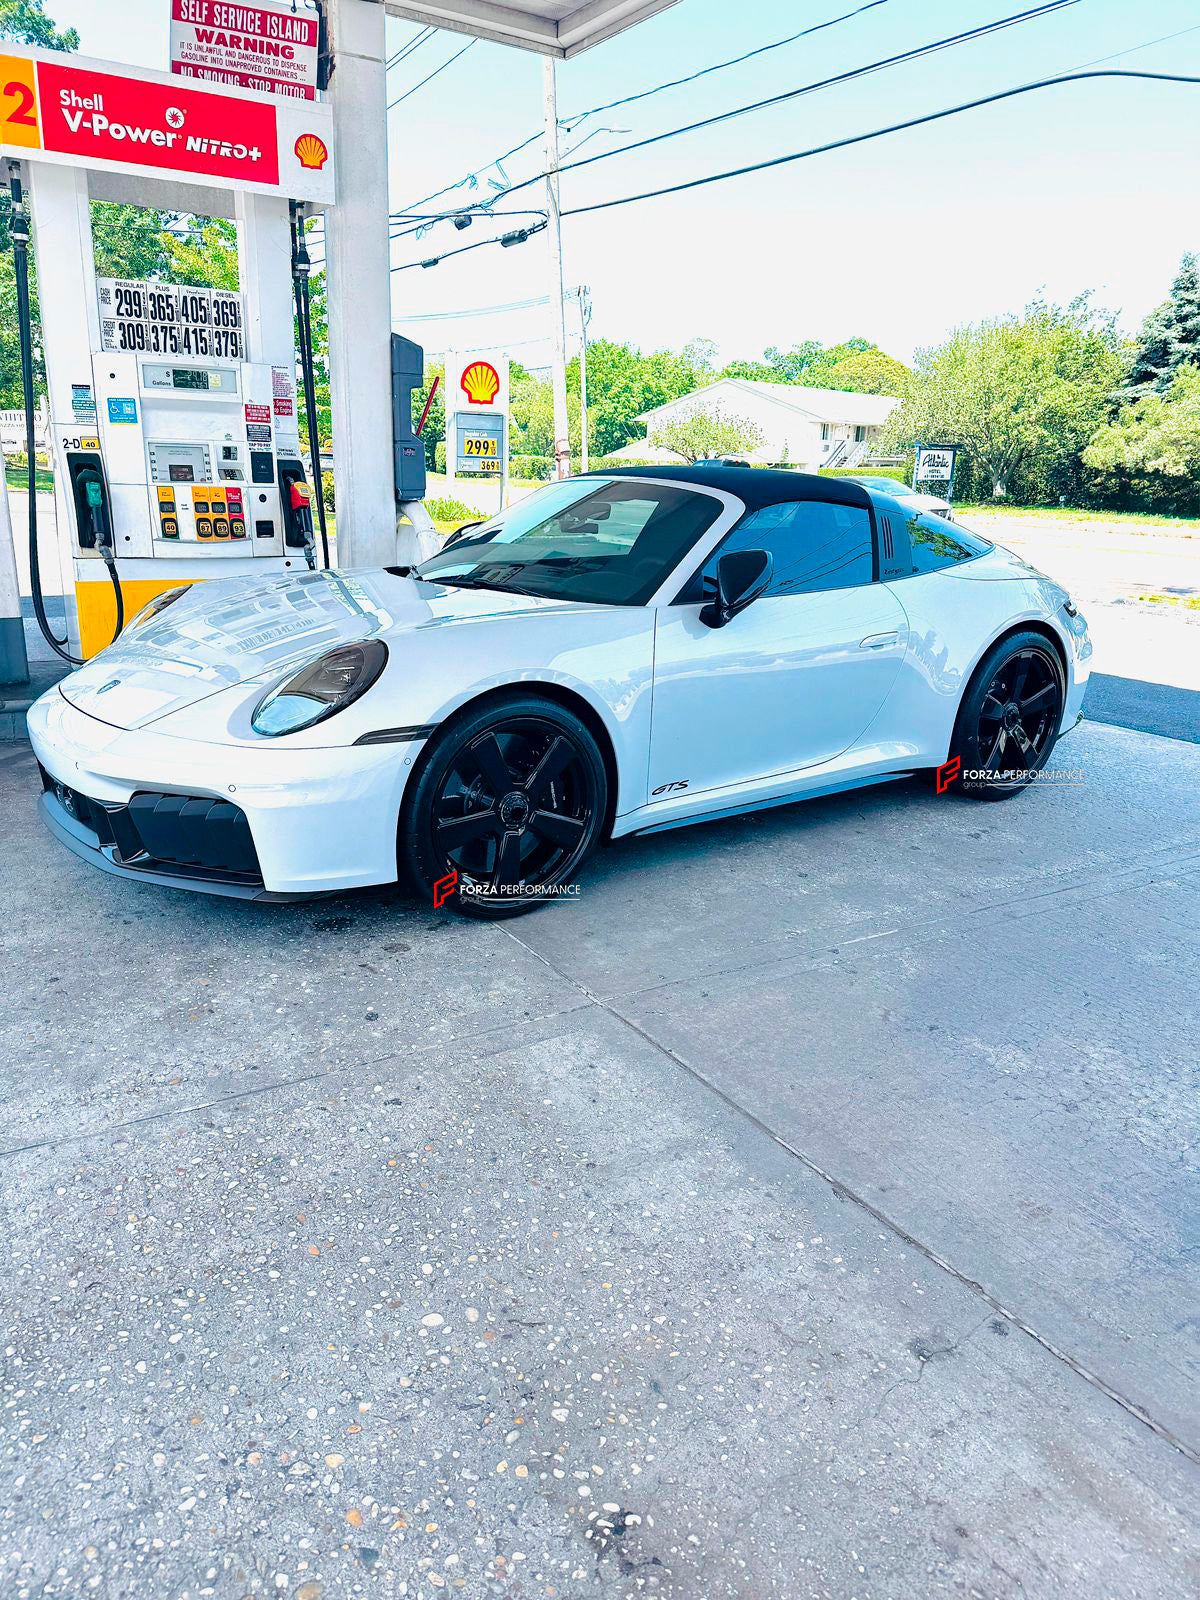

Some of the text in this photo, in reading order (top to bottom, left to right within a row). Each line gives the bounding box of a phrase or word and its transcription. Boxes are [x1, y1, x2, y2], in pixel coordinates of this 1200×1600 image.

[181, 0, 309, 43] SELF SERVICE ISLAND
[180, 41, 307, 73] IT IS UNLAWFUL AND DANGEROUS TO DISPENSE
[194, 27, 295, 60] WARNING
[180, 51, 209, 63] GASOLINE
[210, 56, 223, 66] INTO
[225, 59, 262, 73] UNAPPROVED
[264, 66, 298, 80] CONTAINERS
[180, 66, 306, 100] NO SMOKING STOP MOTOR
[3, 81, 37, 128] 2
[59, 89, 103, 112] Shell
[61, 107, 177, 149] V-Power
[115, 281, 145, 290] REGULAR
[155, 285, 170, 293] PLUS
[215, 291, 235, 299] DIESEL
[115, 288, 142, 318] 299
[149, 292, 175, 322] 365
[213, 300, 238, 328] 369
[183, 327, 208, 355] 415
[214, 330, 239, 358] 379
[62, 438, 80, 449] 2-D
[466, 440, 489, 455] 299
[481, 460, 496, 471] 369
[651, 779, 690, 795] GTS
